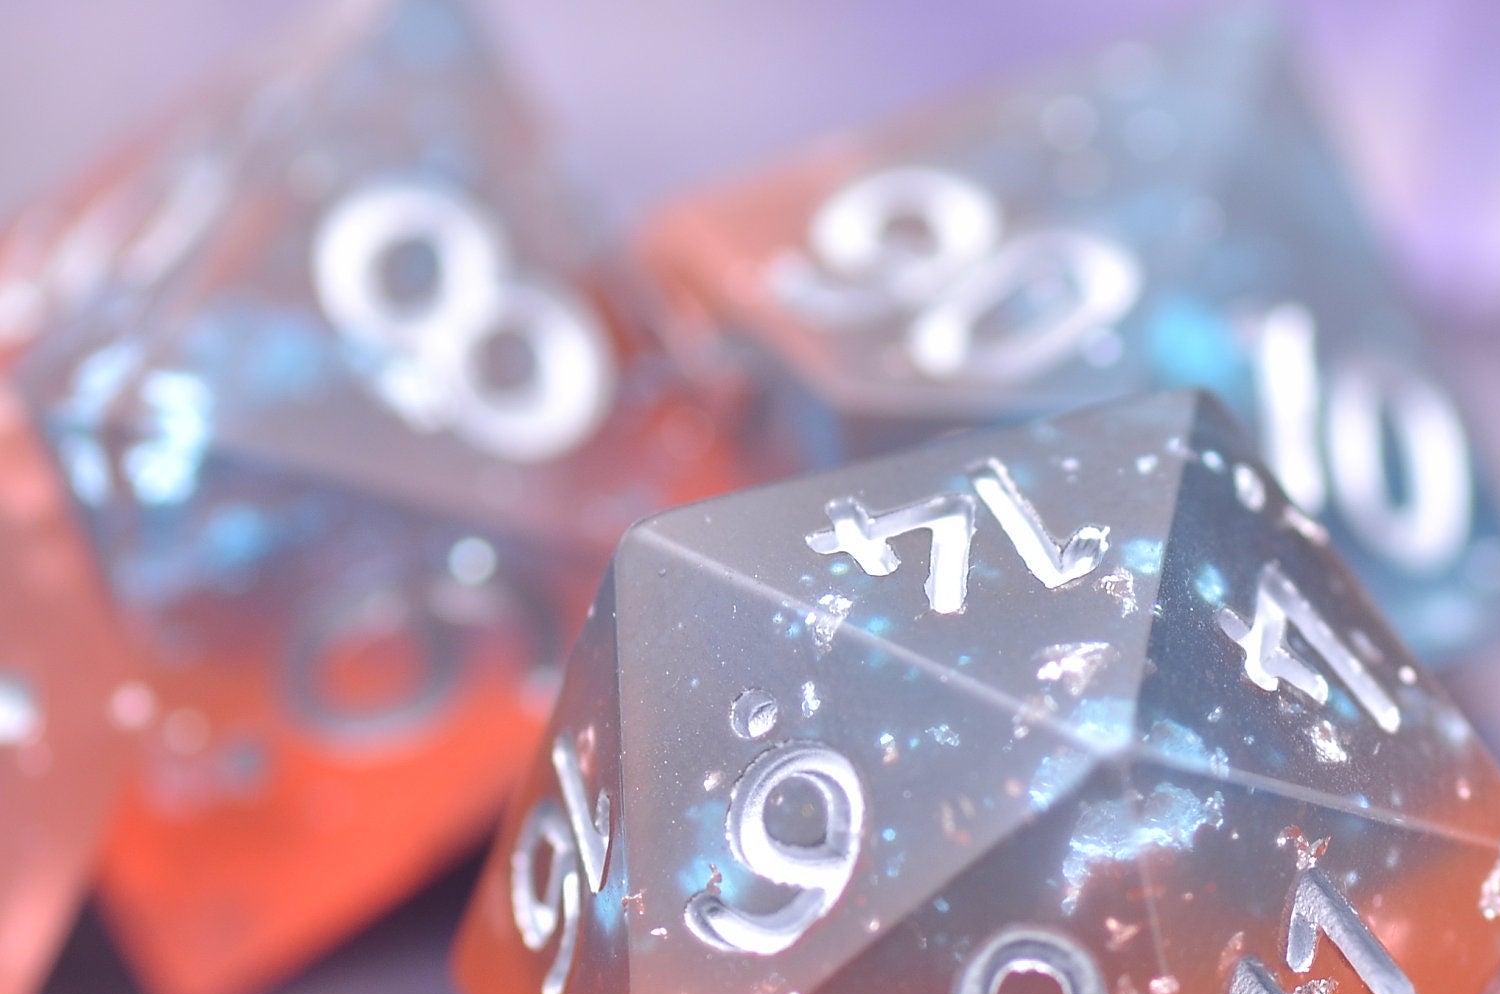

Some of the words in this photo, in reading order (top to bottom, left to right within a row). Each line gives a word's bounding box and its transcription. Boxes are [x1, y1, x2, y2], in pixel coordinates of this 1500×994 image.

[770, 166, 1141, 377] 90
[1255, 300, 1473, 571] 10
[805, 455, 1111, 613] 14
[1217, 559, 1400, 734] 4
